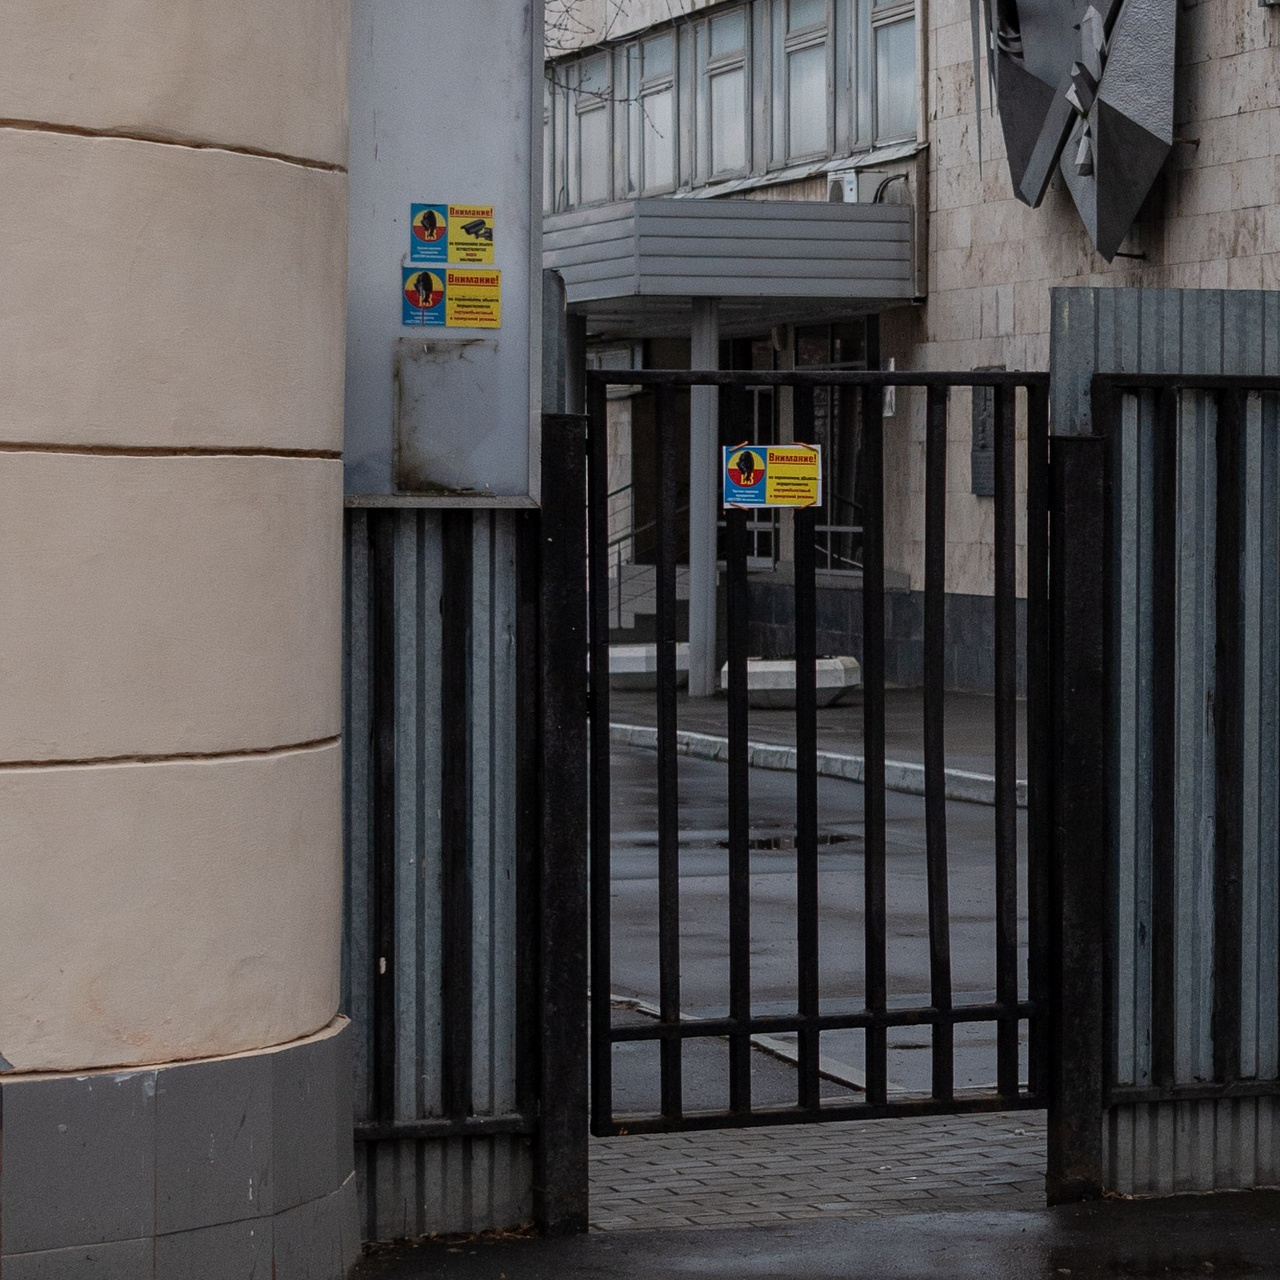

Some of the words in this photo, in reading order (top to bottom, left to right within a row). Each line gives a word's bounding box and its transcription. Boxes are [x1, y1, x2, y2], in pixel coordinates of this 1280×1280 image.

[449, 207, 493, 217] Внимание!
[448, 274, 499, 285] Внимание!
[768, 452, 817, 463] Внимание!
